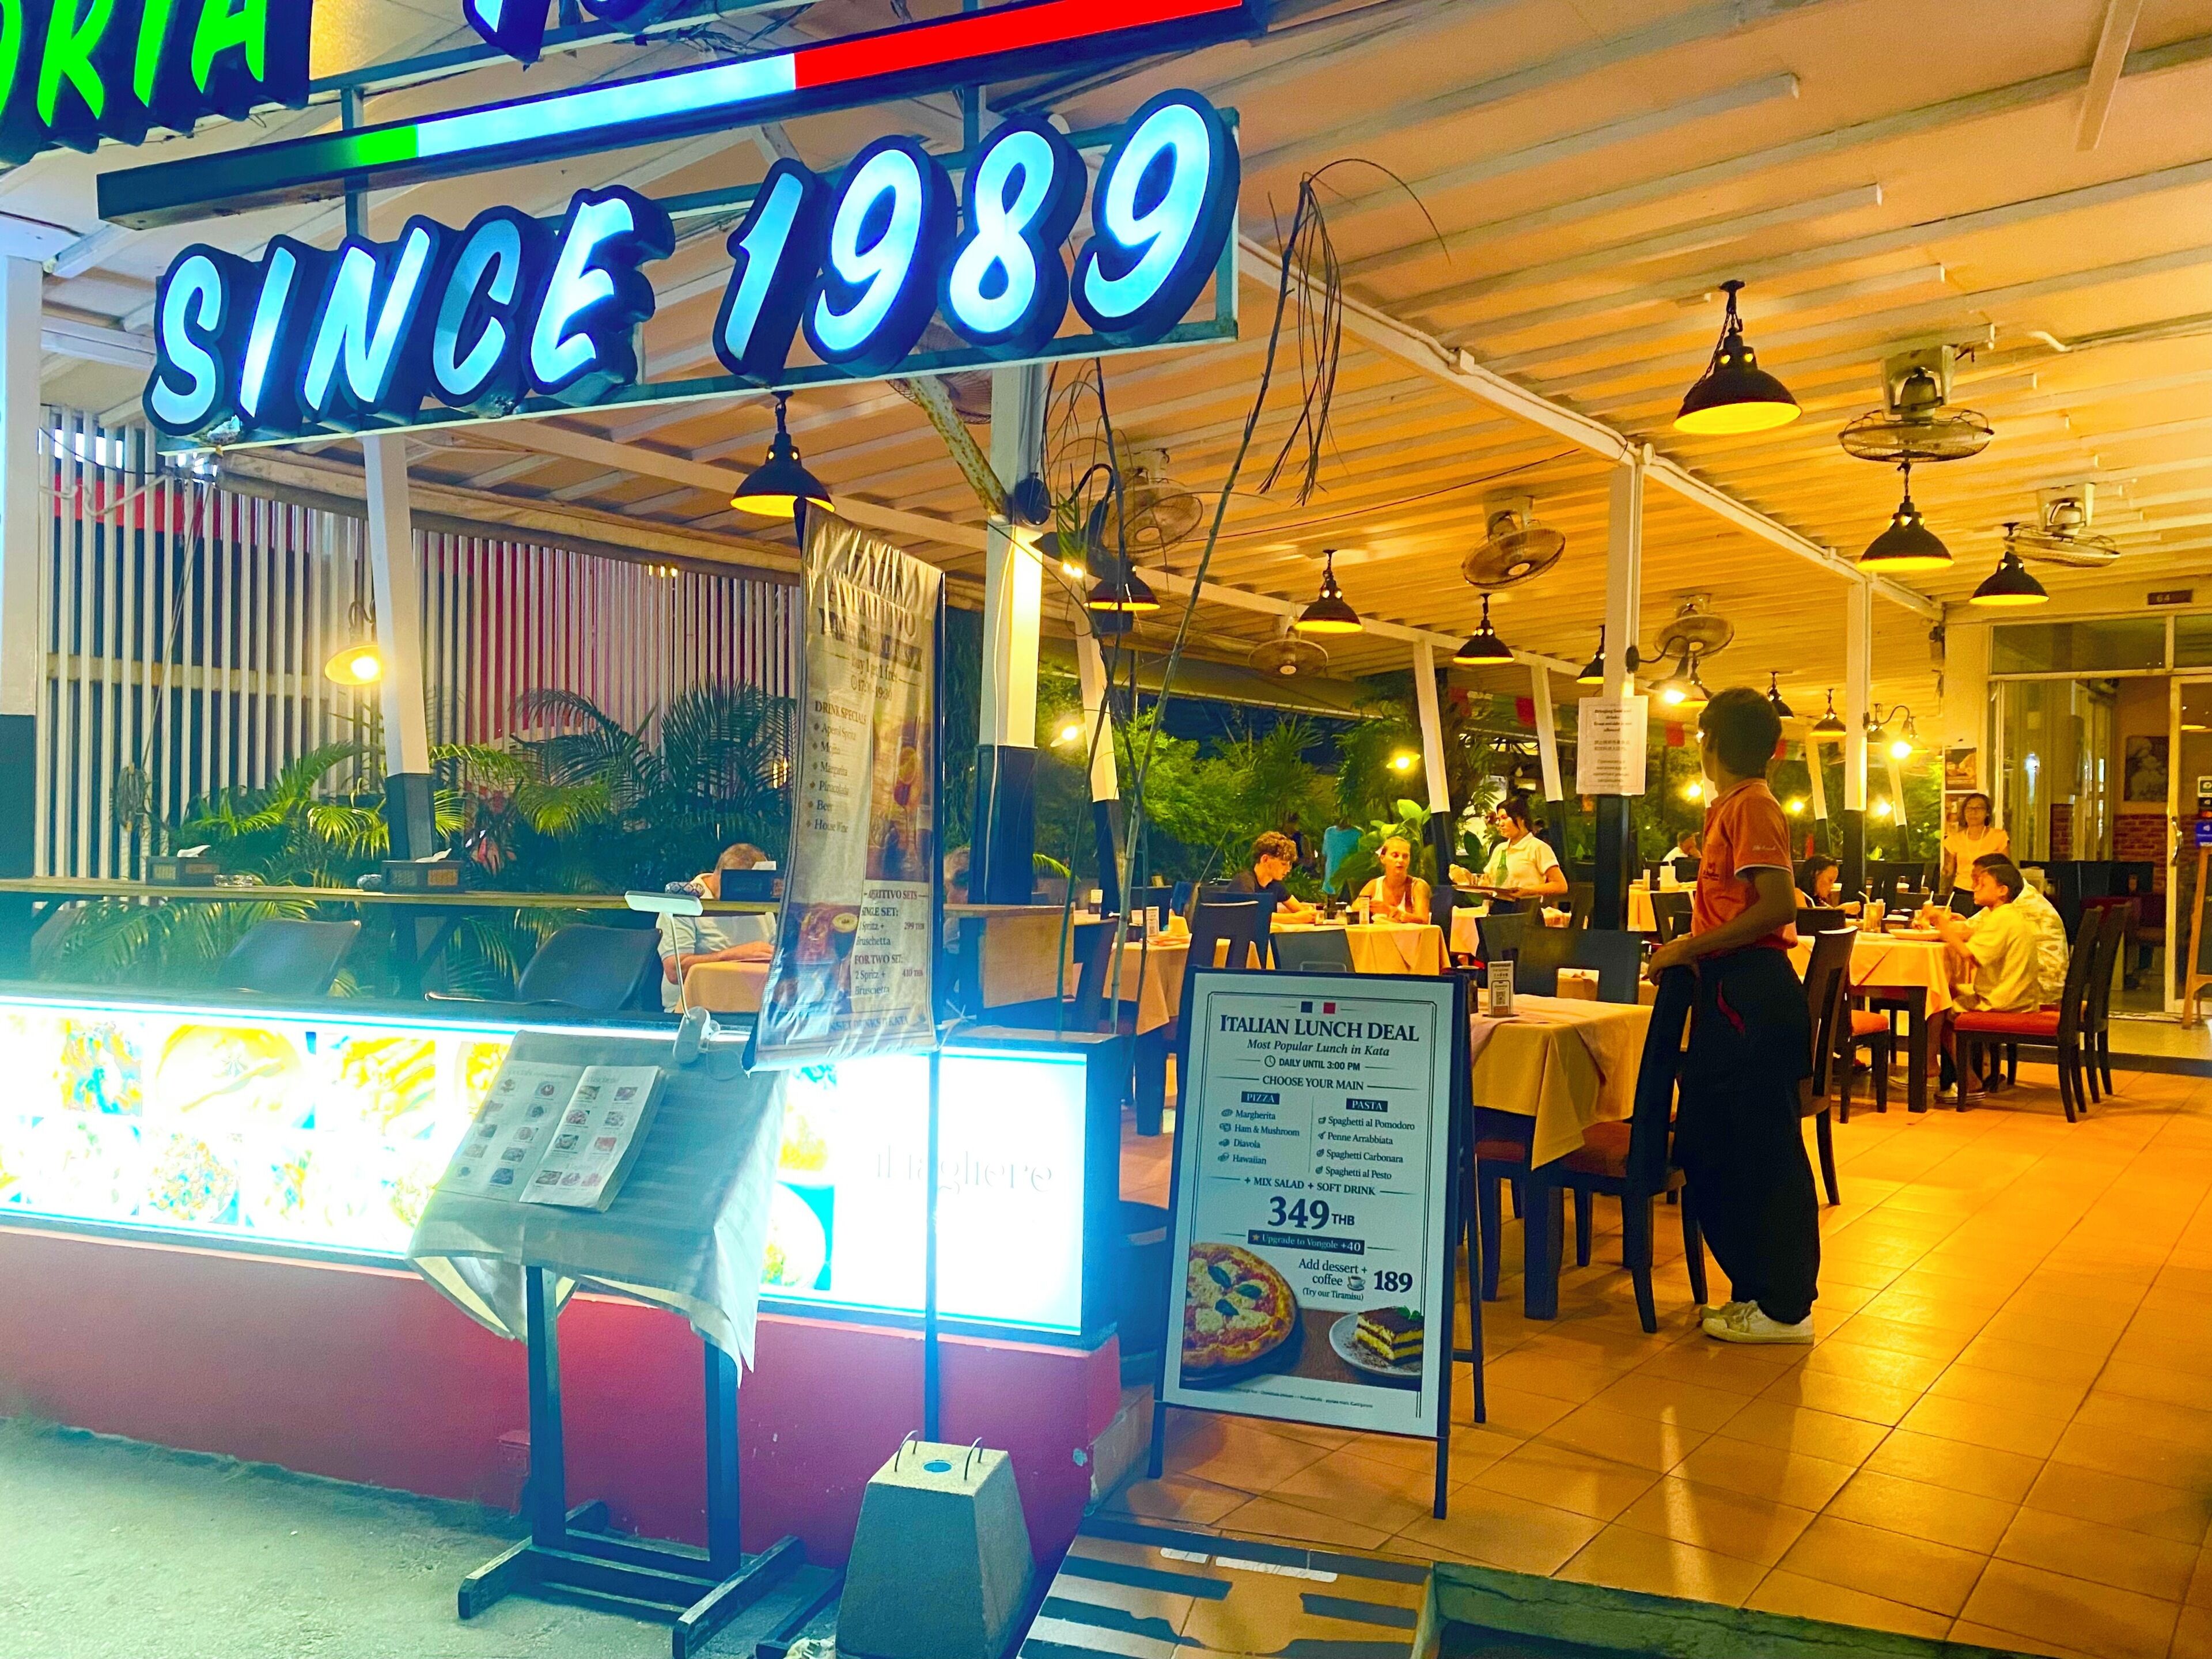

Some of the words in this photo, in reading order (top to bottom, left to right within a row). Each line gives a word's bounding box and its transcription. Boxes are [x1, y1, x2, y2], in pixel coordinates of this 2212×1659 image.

[151, 198, 634, 423] SINCE
[725, 104, 1210, 361] 1989
[2157, 594, 2170, 603] 64
[815, 700, 840, 718] DRINK
[841, 707, 866, 724] SPECIALS
[881, 907, 899, 916] SET:
[904, 921, 915, 930] 299
[855, 954, 870, 964] FOR
[871, 954, 891, 964] TWO
[1220, 1014, 1288, 1035] ITALIAN
[1295, 1020, 1362, 1039] LUNCH
[1368, 1022, 1419, 1042] DEAL
[1247, 1040, 1271, 1051] Most
[1274, 1041, 1313, 1054] Popular
[1316, 1043, 1348, 1054] Lunch
[1351, 1045, 1361, 1055] in
[1364, 1046, 1389, 1056] Kata
[1279, 1059, 1300, 1068] DAILY
[1302, 1060, 1324, 1069] UNTIL
[1327, 1061, 1345, 1070] 3:00
[1347, 1062, 1360, 1071] PM
[1263, 1075, 1303, 1087] CHOOSE
[1305, 1078, 1334, 1089] YOUR
[1336, 1080, 1363, 1090] MAIN
[1246, 1093, 1275, 1103] PIZZA
[1352, 1101, 1382, 1111] PASTA
[1236, 1110, 1275, 1121] Margherita
[1328, 1116, 1363, 1128] Spaghetti
[1366, 1119, 1372, 1128] al
[1374, 1119, 1415, 1131] Pomodoro
[1235, 1124, 1251, 1133] Ham
[1253, 1125, 1259, 1134] &
[1261, 1126, 1300, 1137] Mushroom
[1233, 1139, 1260, 1149] Diavola
[1327, 1132, 1350, 1142] Penne
[1352, 1133, 1393, 1145] Arrabbiata
[1233, 1155, 1267, 1165] Hawaiian
[1327, 1149, 1362, 1162] Spaghetti
[1364, 1153, 1403, 1164] Carbonara
[1325, 1166, 1361, 1179] Spaghetti
[1363, 1169, 1369, 1179] al
[1372, 1170, 1392, 1180] Pesto
[1254, 1177, 1272, 1187] MIX
[1275, 1179, 1304, 1190] SALAD
[1317, 1181, 1342, 1193] SOFT
[1344, 1184, 1376, 1196] DRINK
[1267, 1196, 1330, 1229] 349
[1332, 1214, 1354, 1226] THB
[1262, 1234, 1294, 1246] Upgrade
[1307, 1238, 1338, 1250] Vongole
[1341, 1241, 1361, 1252] +40
[1300, 1259, 1320, 1270] Add
[1323, 1260, 1358, 1273] dessert
[1313, 1274, 1342, 1286] coffee
[1374, 1271, 1412, 1292] 189
[1302, 1287, 1316, 1297] (Try
[1332, 1291, 1363, 1300] Tiramisu)
